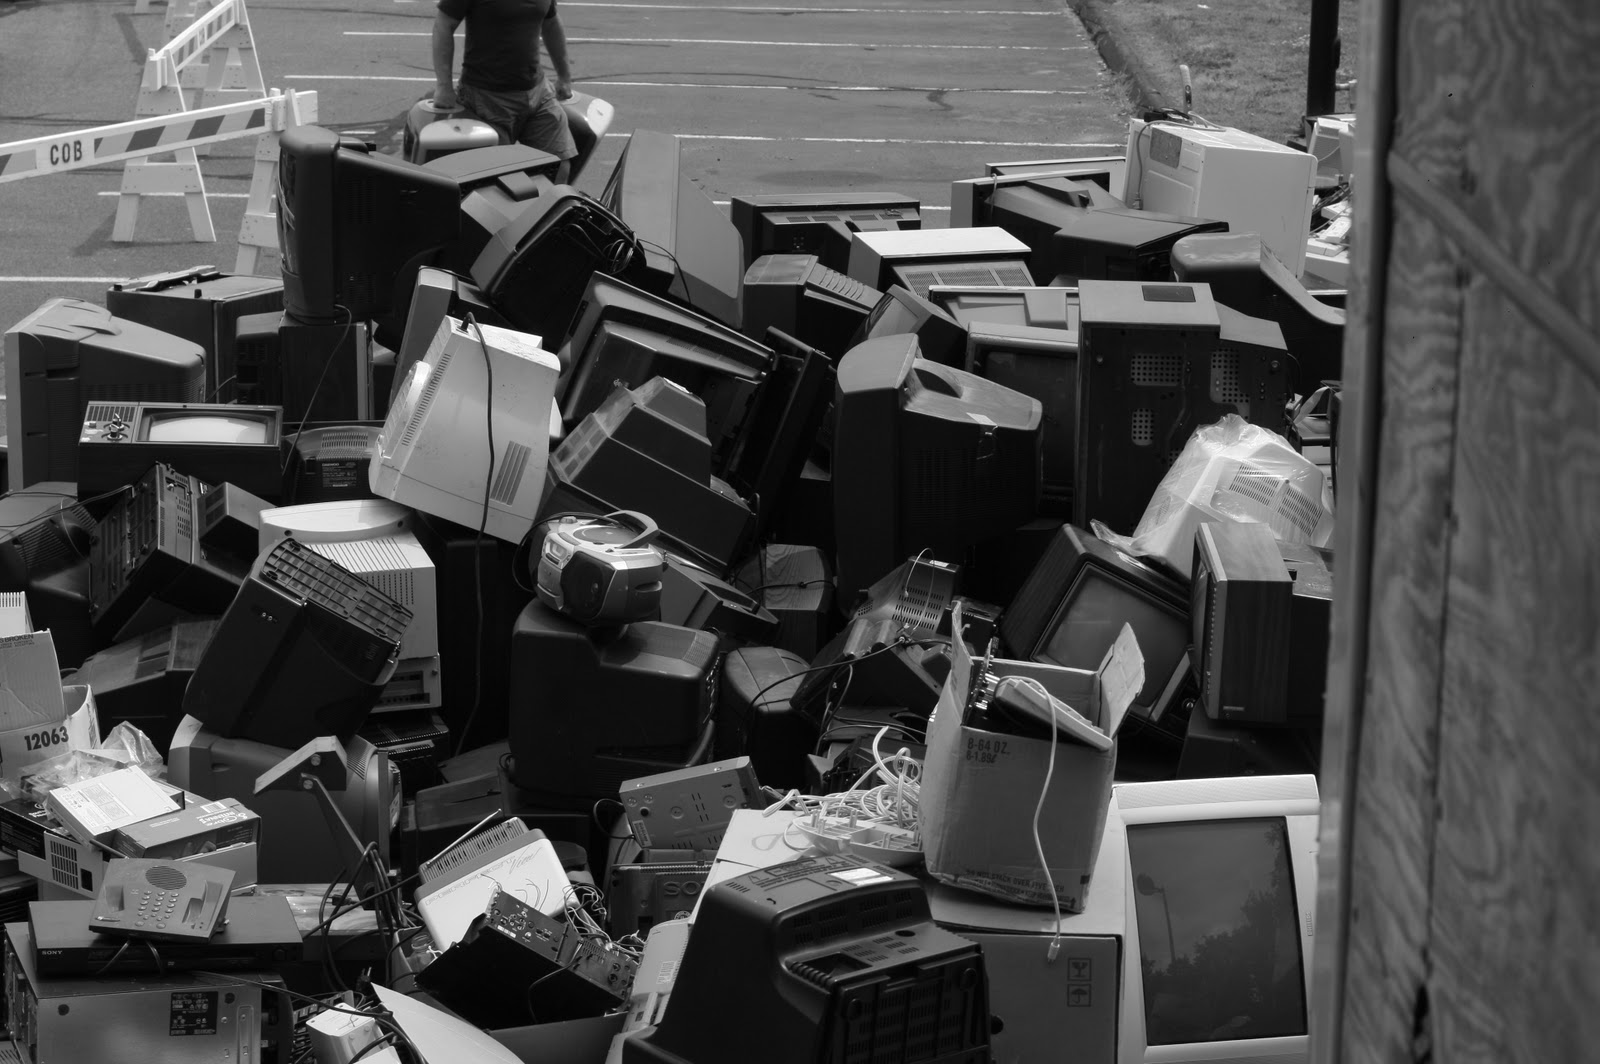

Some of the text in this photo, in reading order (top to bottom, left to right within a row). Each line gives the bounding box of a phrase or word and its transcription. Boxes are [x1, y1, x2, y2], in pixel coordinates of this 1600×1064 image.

[50, 139, 83, 166] COB
[24, 725, 69, 751] 12063
[967, 737, 991, 752] 8-64
[1013, 877, 1032, 888] OVER
